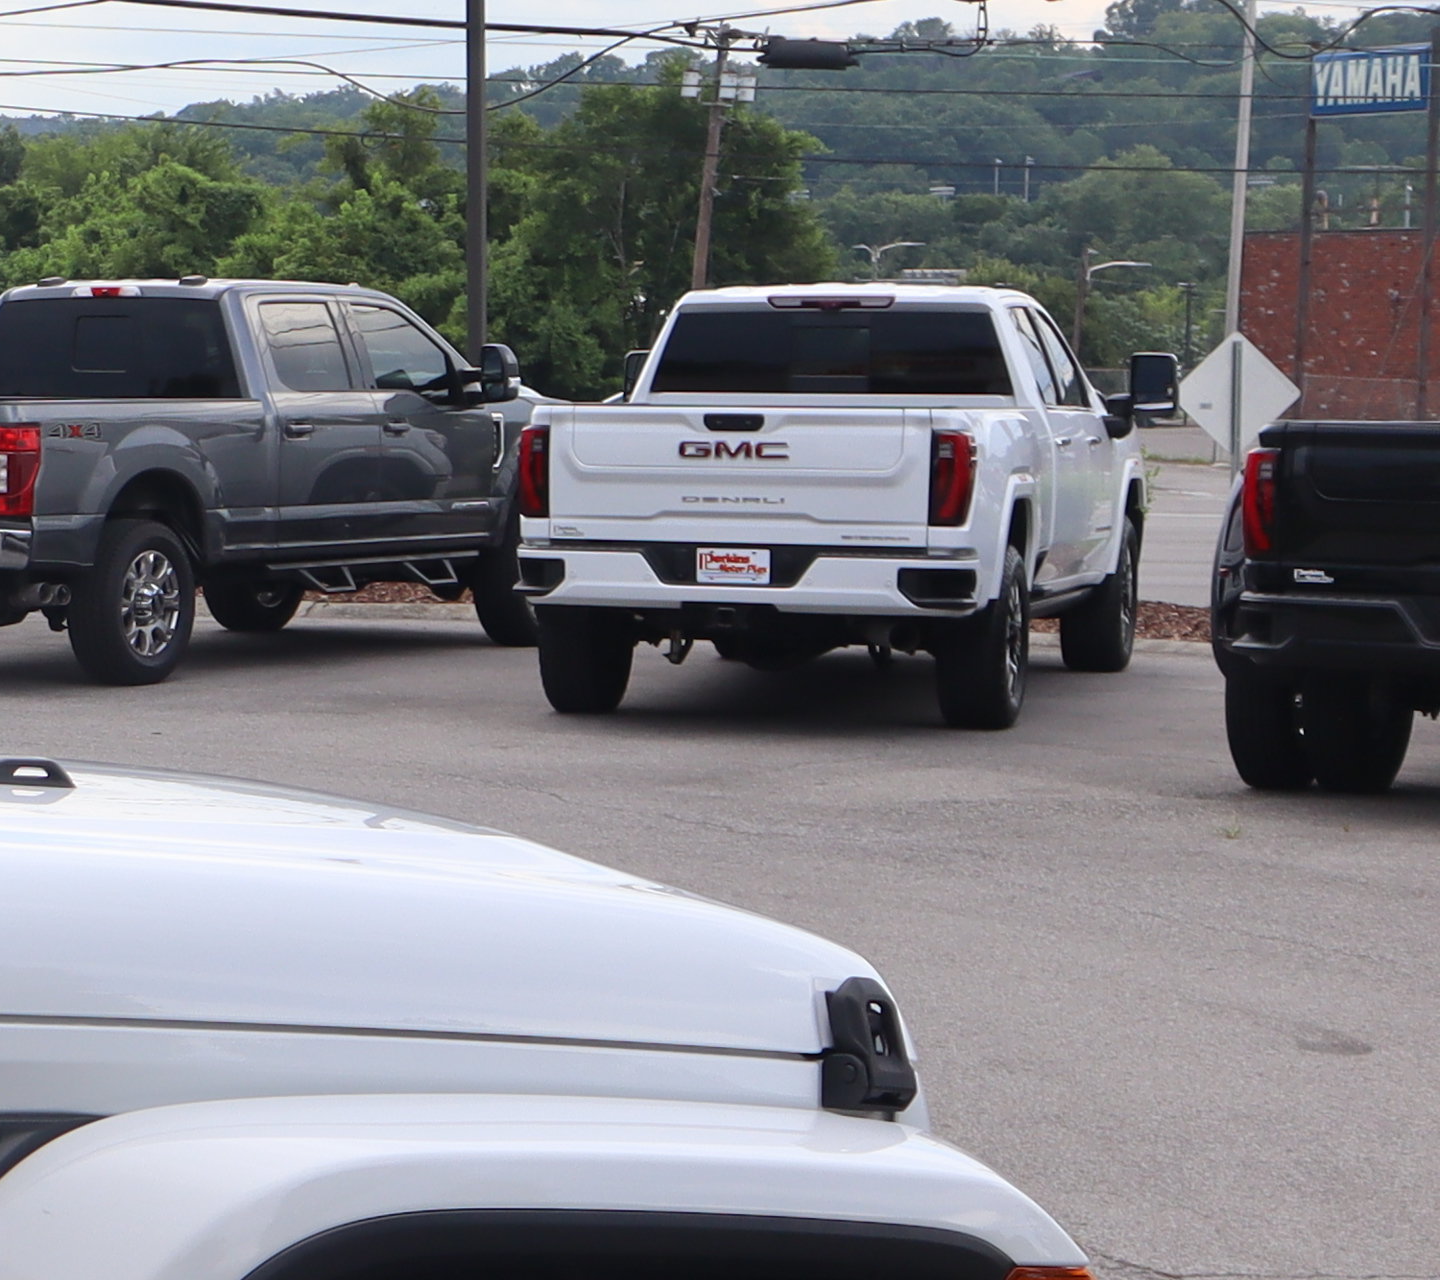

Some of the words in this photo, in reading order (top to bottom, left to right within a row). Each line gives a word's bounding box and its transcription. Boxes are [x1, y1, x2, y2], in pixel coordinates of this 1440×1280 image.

[1315, 55, 1422, 107] YAMAHA
[678, 440, 790, 461] GMC
[681, 496, 786, 505] DENALI
[699, 552, 751, 570] Perkins
